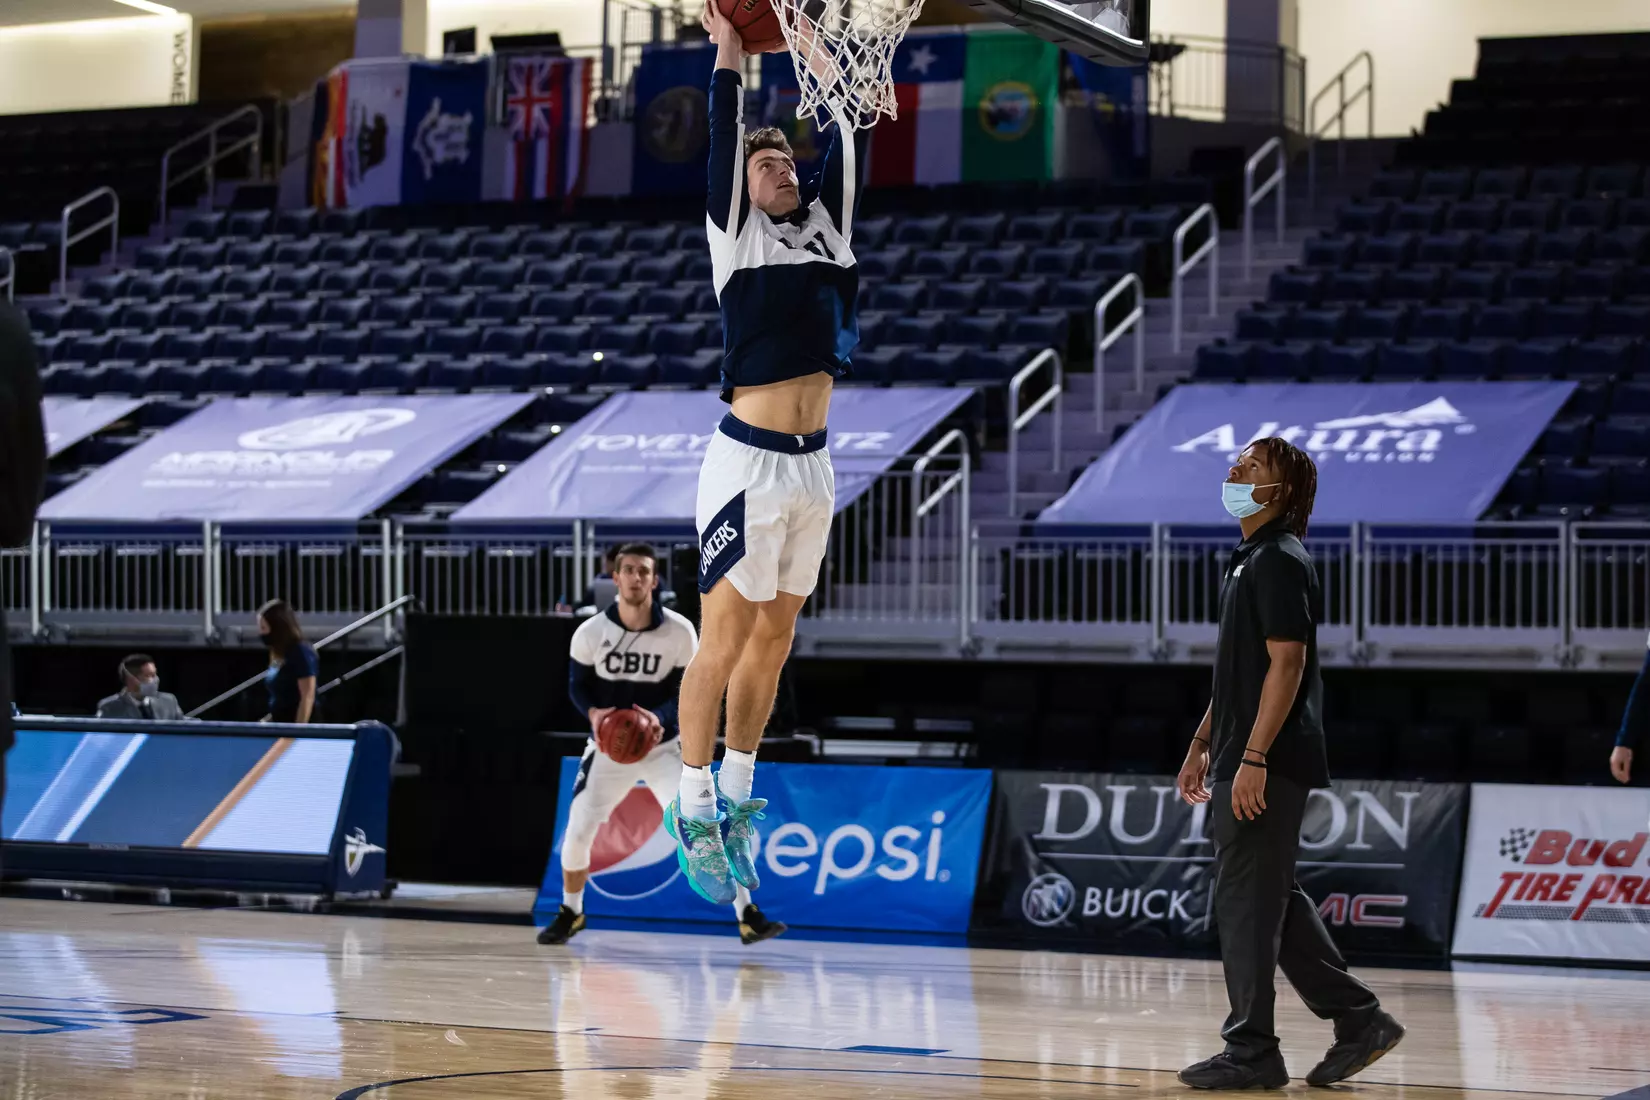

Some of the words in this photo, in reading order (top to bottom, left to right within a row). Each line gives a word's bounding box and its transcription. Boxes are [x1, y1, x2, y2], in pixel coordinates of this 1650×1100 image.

[701, 520, 738, 576] LANCERS
[605, 651, 662, 675] CBU
[1033, 783, 1421, 850] DUTON
[750, 810, 946, 895] epsi
[1081, 886, 1193, 921] BUICK
[1482, 872, 1584, 918] TIRE
